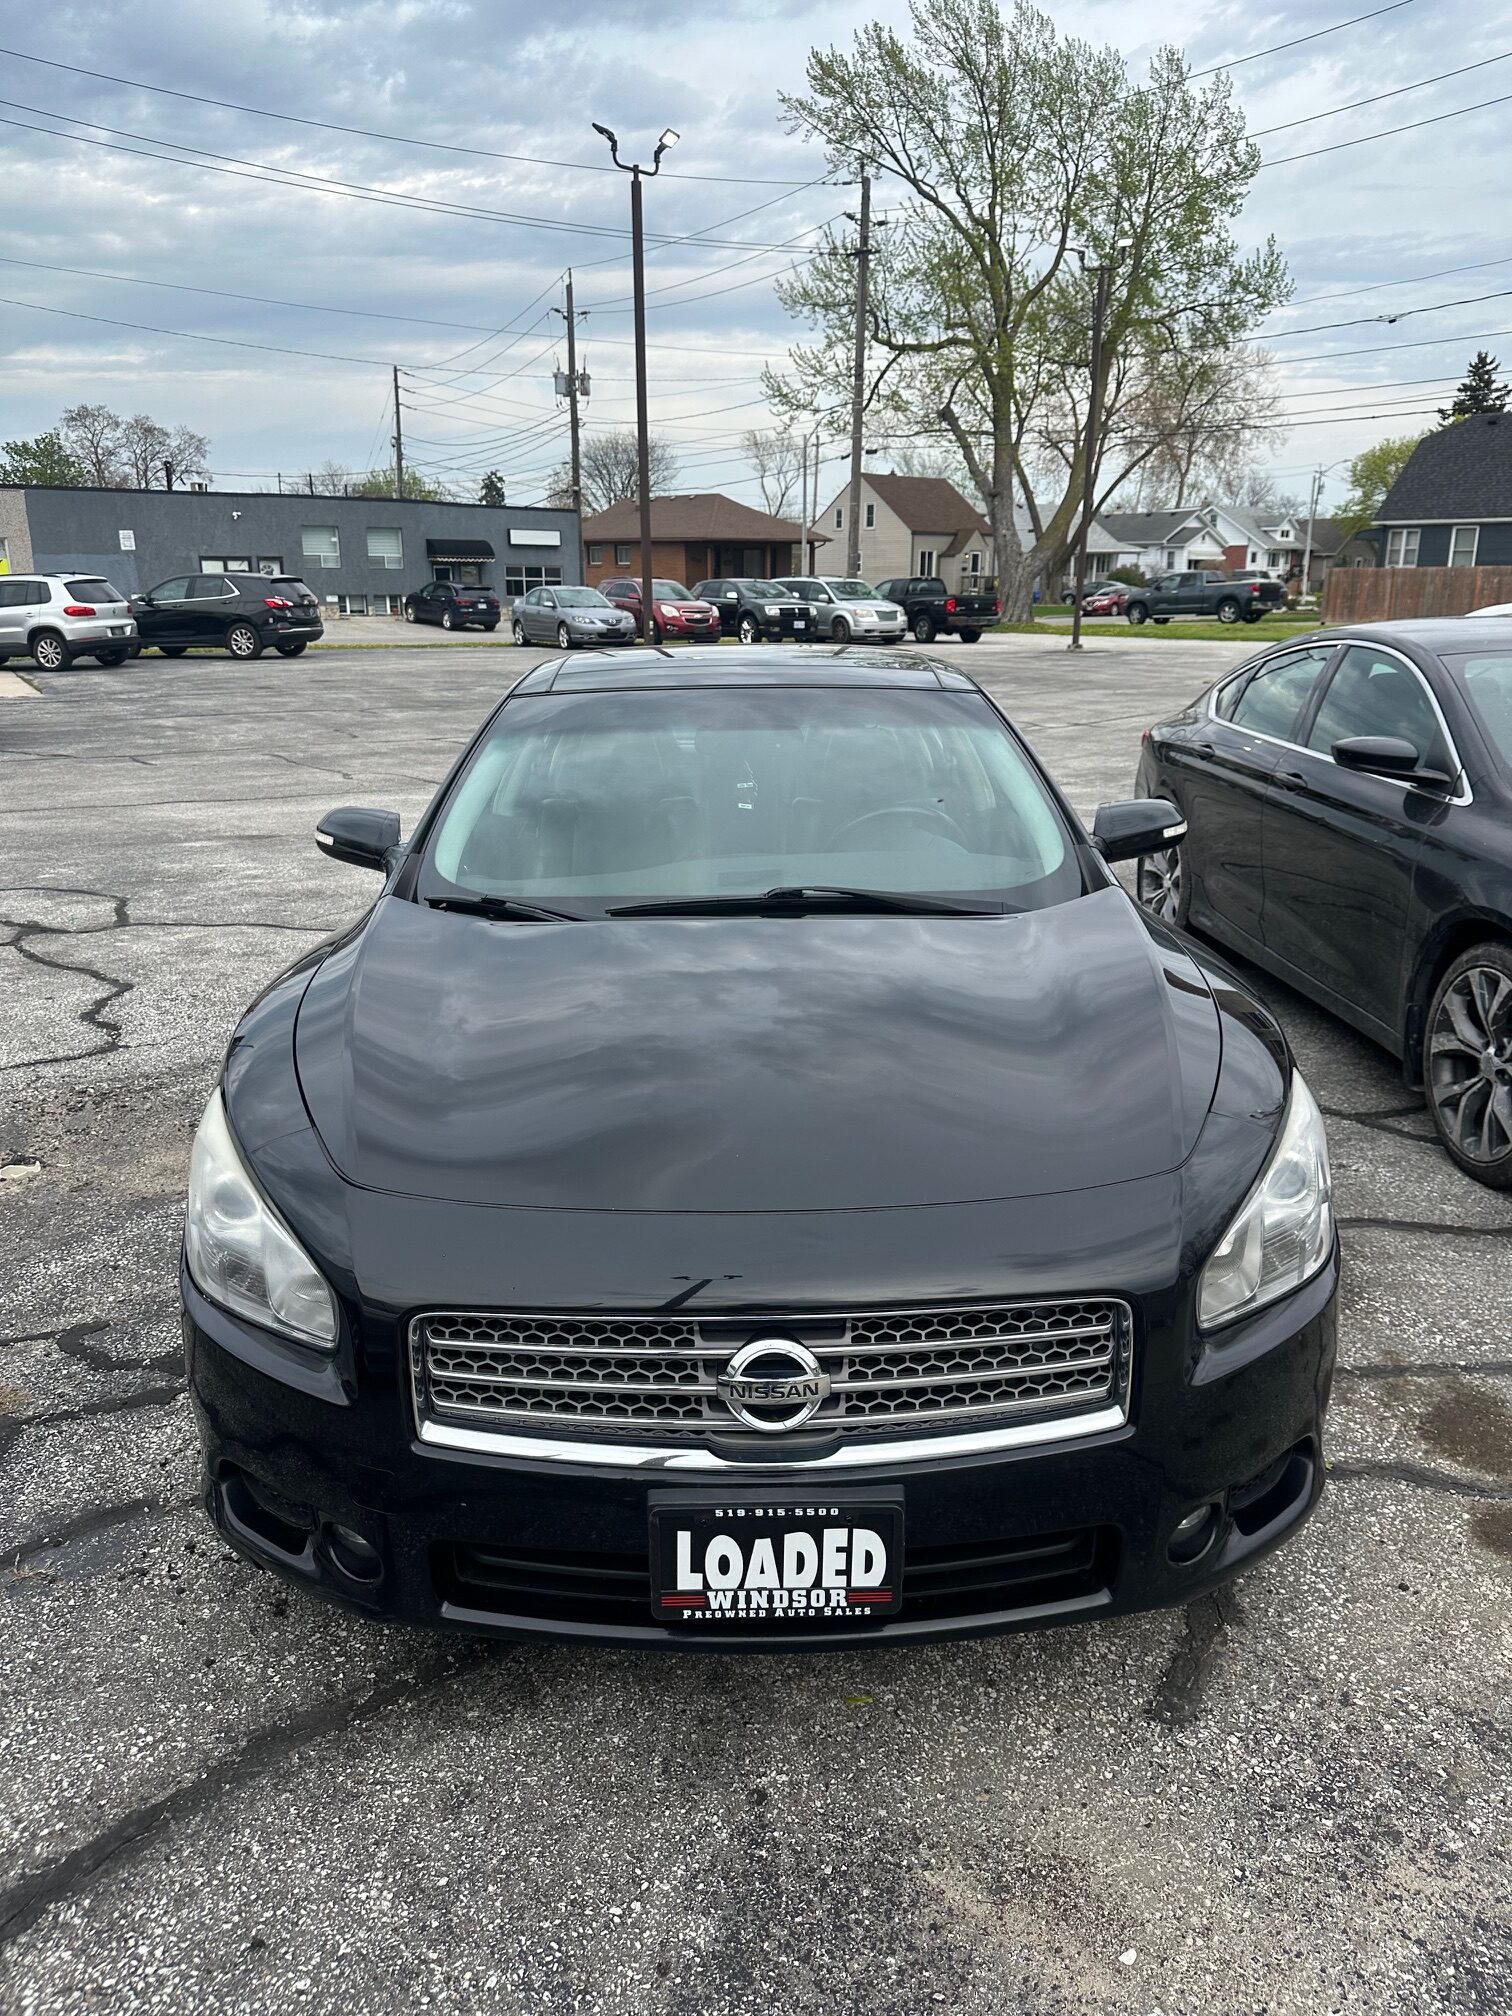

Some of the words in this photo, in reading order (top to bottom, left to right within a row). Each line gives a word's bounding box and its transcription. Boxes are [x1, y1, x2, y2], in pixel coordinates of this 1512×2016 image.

[729, 1382, 819, 1399] NISSAN
[715, 1508, 839, 1517] 519-915-5500
[676, 1528, 887, 1591] LOADED
[706, 1589, 848, 1610] WINDSOR
[683, 1609, 767, 1619] PREOWNED
[774, 1608, 816, 1617] AUTO
[824, 1607, 872, 1616] SALES
